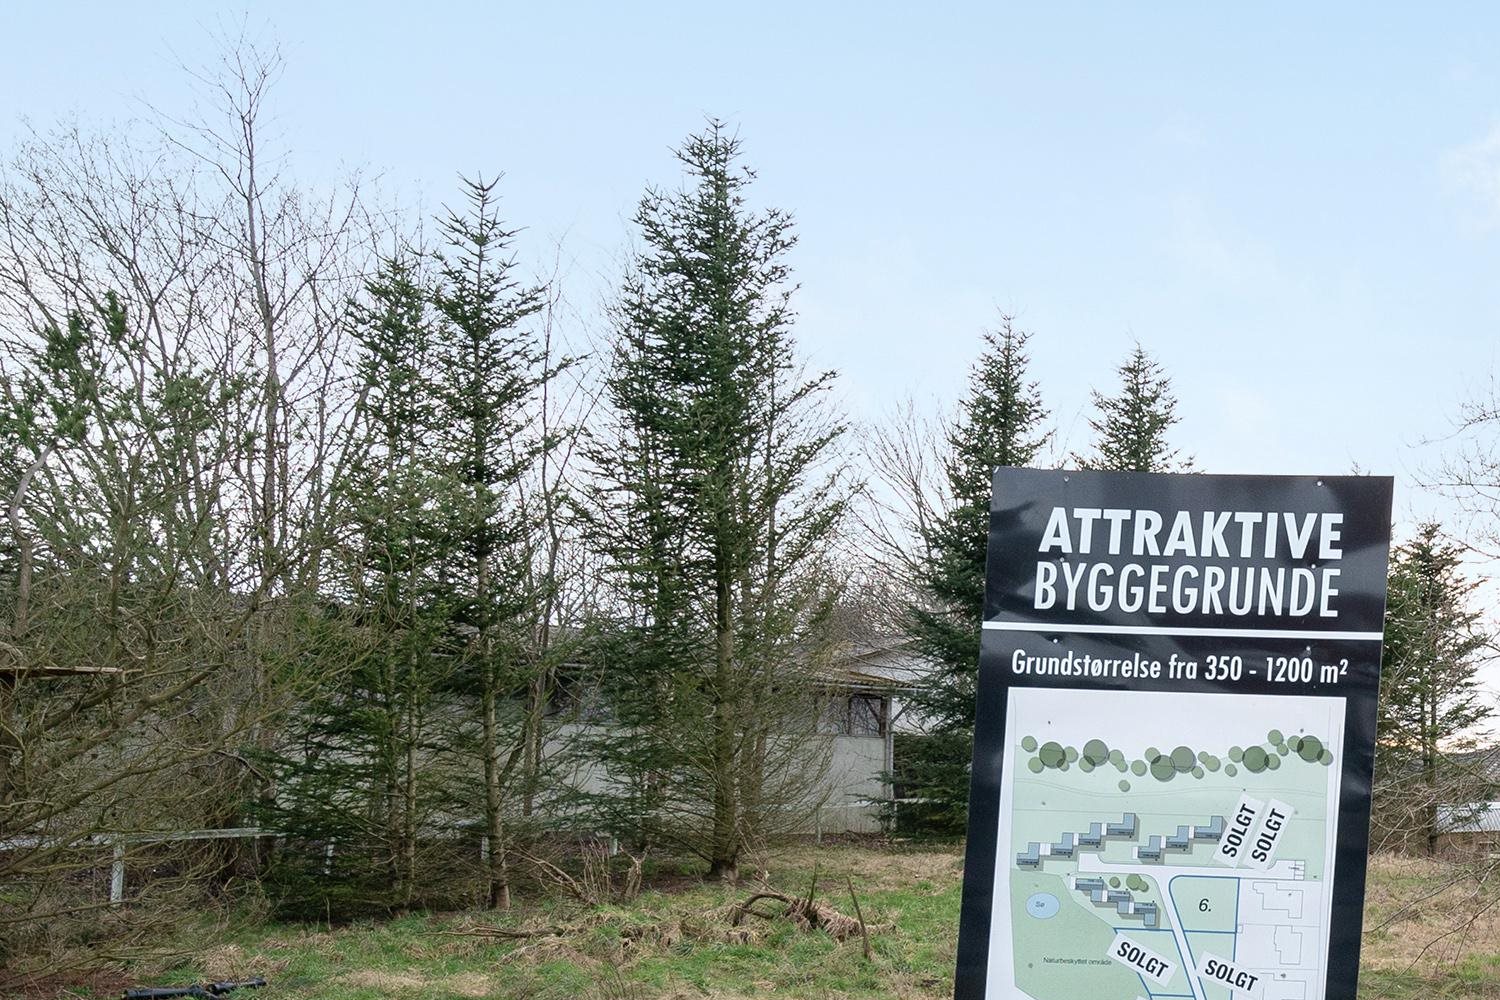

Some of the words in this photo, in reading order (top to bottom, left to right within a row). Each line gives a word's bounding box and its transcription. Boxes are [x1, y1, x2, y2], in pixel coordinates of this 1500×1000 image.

[1038, 506, 1344, 560] ATTRAKTIVE
[1033, 561, 1341, 618] BYGGEGRUNDE
[1011, 649, 1162, 679] Grundstørrelse
[1168, 653, 1198, 680] fra
[1204, 654, 1243, 681] 350
[1266, 656, 1314, 683] 1200
[1222, 803, 1257, 858] SOLGT
[1251, 807, 1286, 863] SOLGT
[1198, 898, 1212, 912] 6.
[1117, 941, 1169, 979] SOLGT
[1205, 959, 1259, 992] SOLGT
